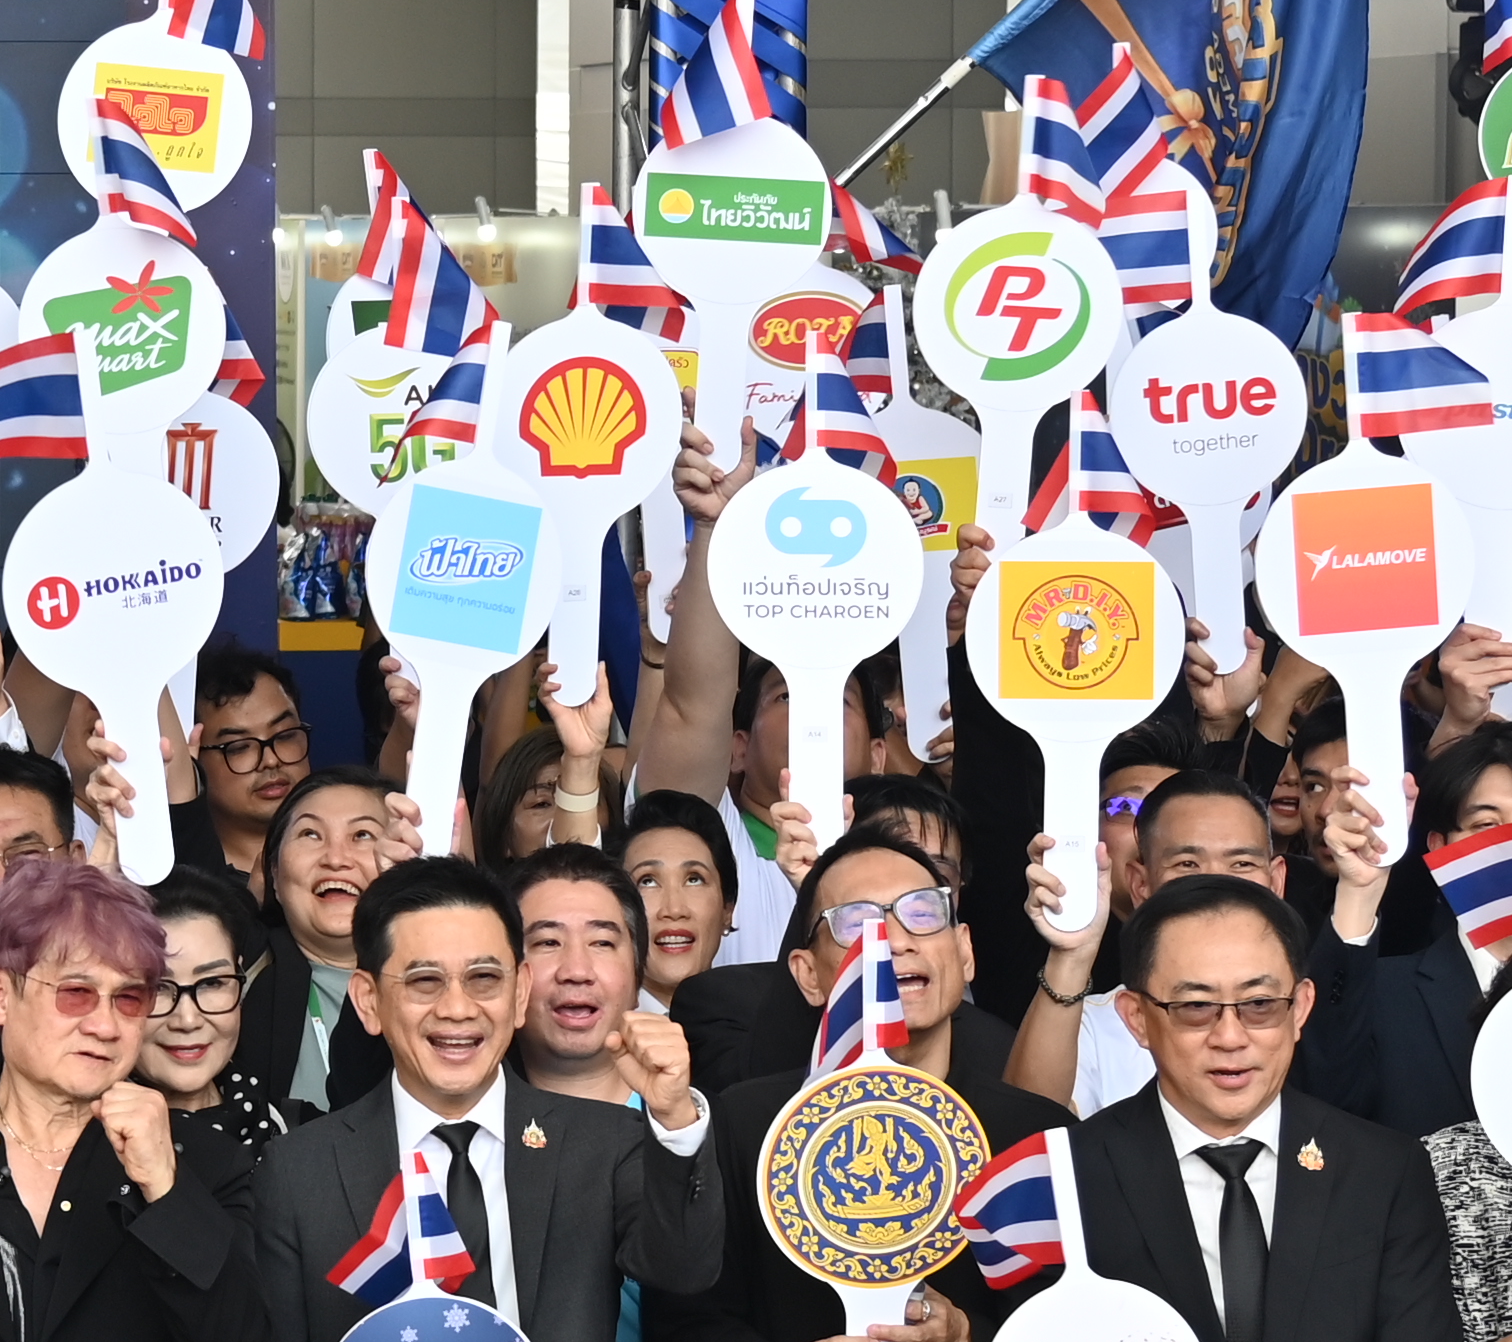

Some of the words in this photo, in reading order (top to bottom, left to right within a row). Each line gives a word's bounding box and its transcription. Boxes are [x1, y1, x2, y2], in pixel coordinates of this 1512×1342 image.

[733, 191, 778, 206] ประกันภัย
[700, 198, 812, 232] ไทยวิวัฒน์
[975, 265, 1063, 352] PT
[1143, 376, 1278, 425] true
[1172, 430, 1260, 457] together
[1331, 548, 1427, 570] LALAMOVE
[121, 589, 169, 610] 北海道
[742, 574, 890, 601] แว่นท็อปเจริญ
[742, 604, 785, 620] TOP
[789, 604, 891, 620] CHAROEN
[1032, 643, 1064, 680] Always
[1065, 669, 1091, 683] Low
[1091, 643, 1120, 677] Prices
